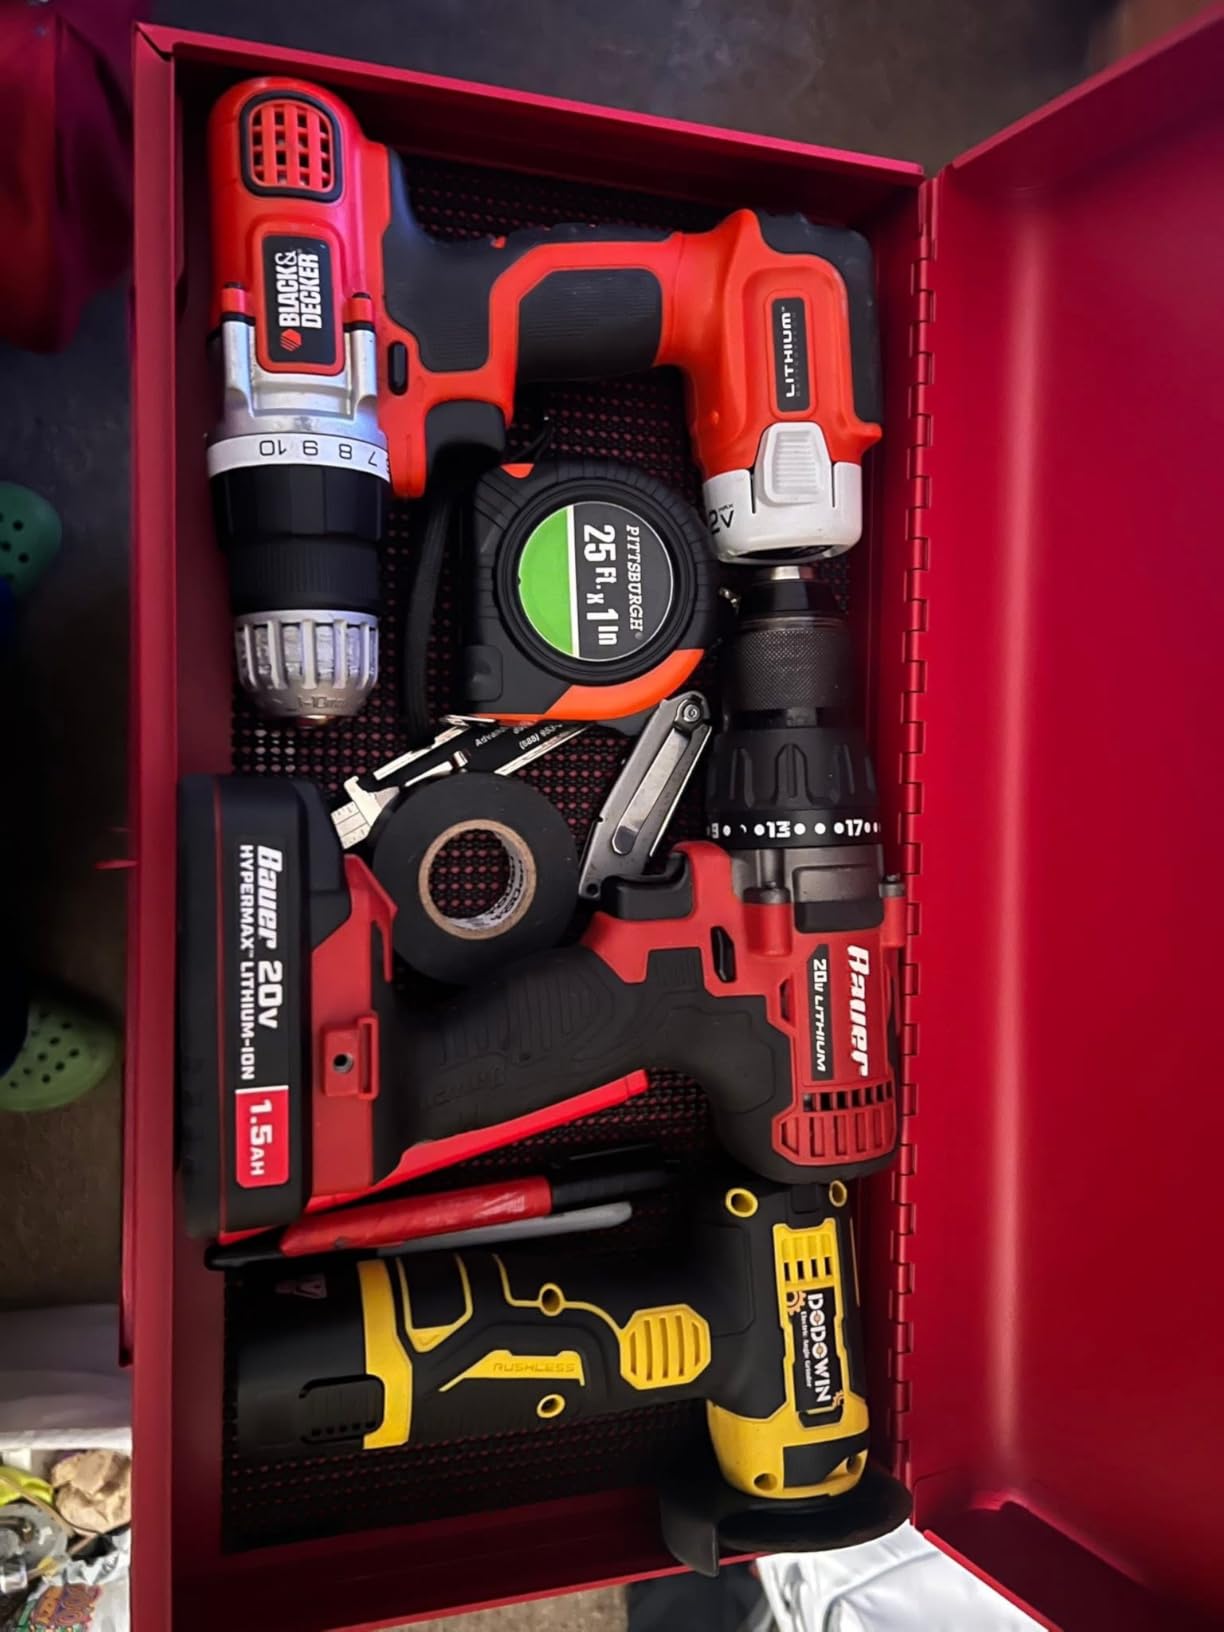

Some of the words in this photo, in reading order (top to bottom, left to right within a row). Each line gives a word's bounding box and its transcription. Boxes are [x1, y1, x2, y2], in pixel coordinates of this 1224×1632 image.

[298, 253, 322, 329] DECKER
[781, 312, 795, 398] LITHIUM
[259, 439, 287, 456] 10
[302, 440, 318, 456] 9
[338, 444, 352, 459] 8
[368, 451, 378, 467] 7
[583, 525, 616, 562] 25
[586, 593, 605, 604] x
[766, 821, 791, 838] 13
[845, 819, 864, 837] 17
[258, 845, 283, 949] Bauer
[241, 961, 255, 1080] LITHIUM-ION
[258, 960, 283, 1029] 20V
[847, 945, 870, 1077] Bauer
[815, 995, 826, 1072] LITHIUM
[807, 1293, 831, 1402] DODOWIN
